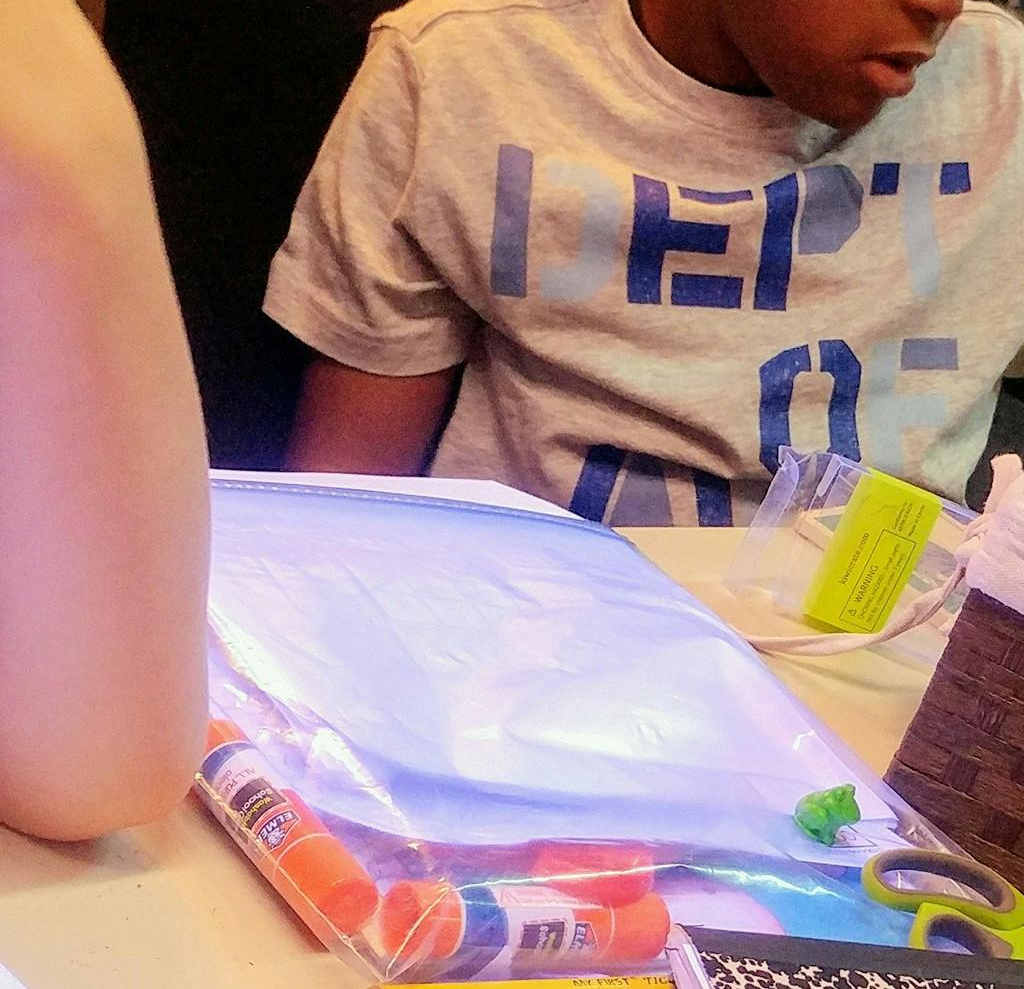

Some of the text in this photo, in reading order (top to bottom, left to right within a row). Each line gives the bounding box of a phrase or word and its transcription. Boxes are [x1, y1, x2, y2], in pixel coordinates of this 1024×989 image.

[490, 143, 972, 312] DEPT
[759, 338, 958, 477] OF
[854, 563, 880, 603] WARNING
[596, 977, 630, 987] FIRST
